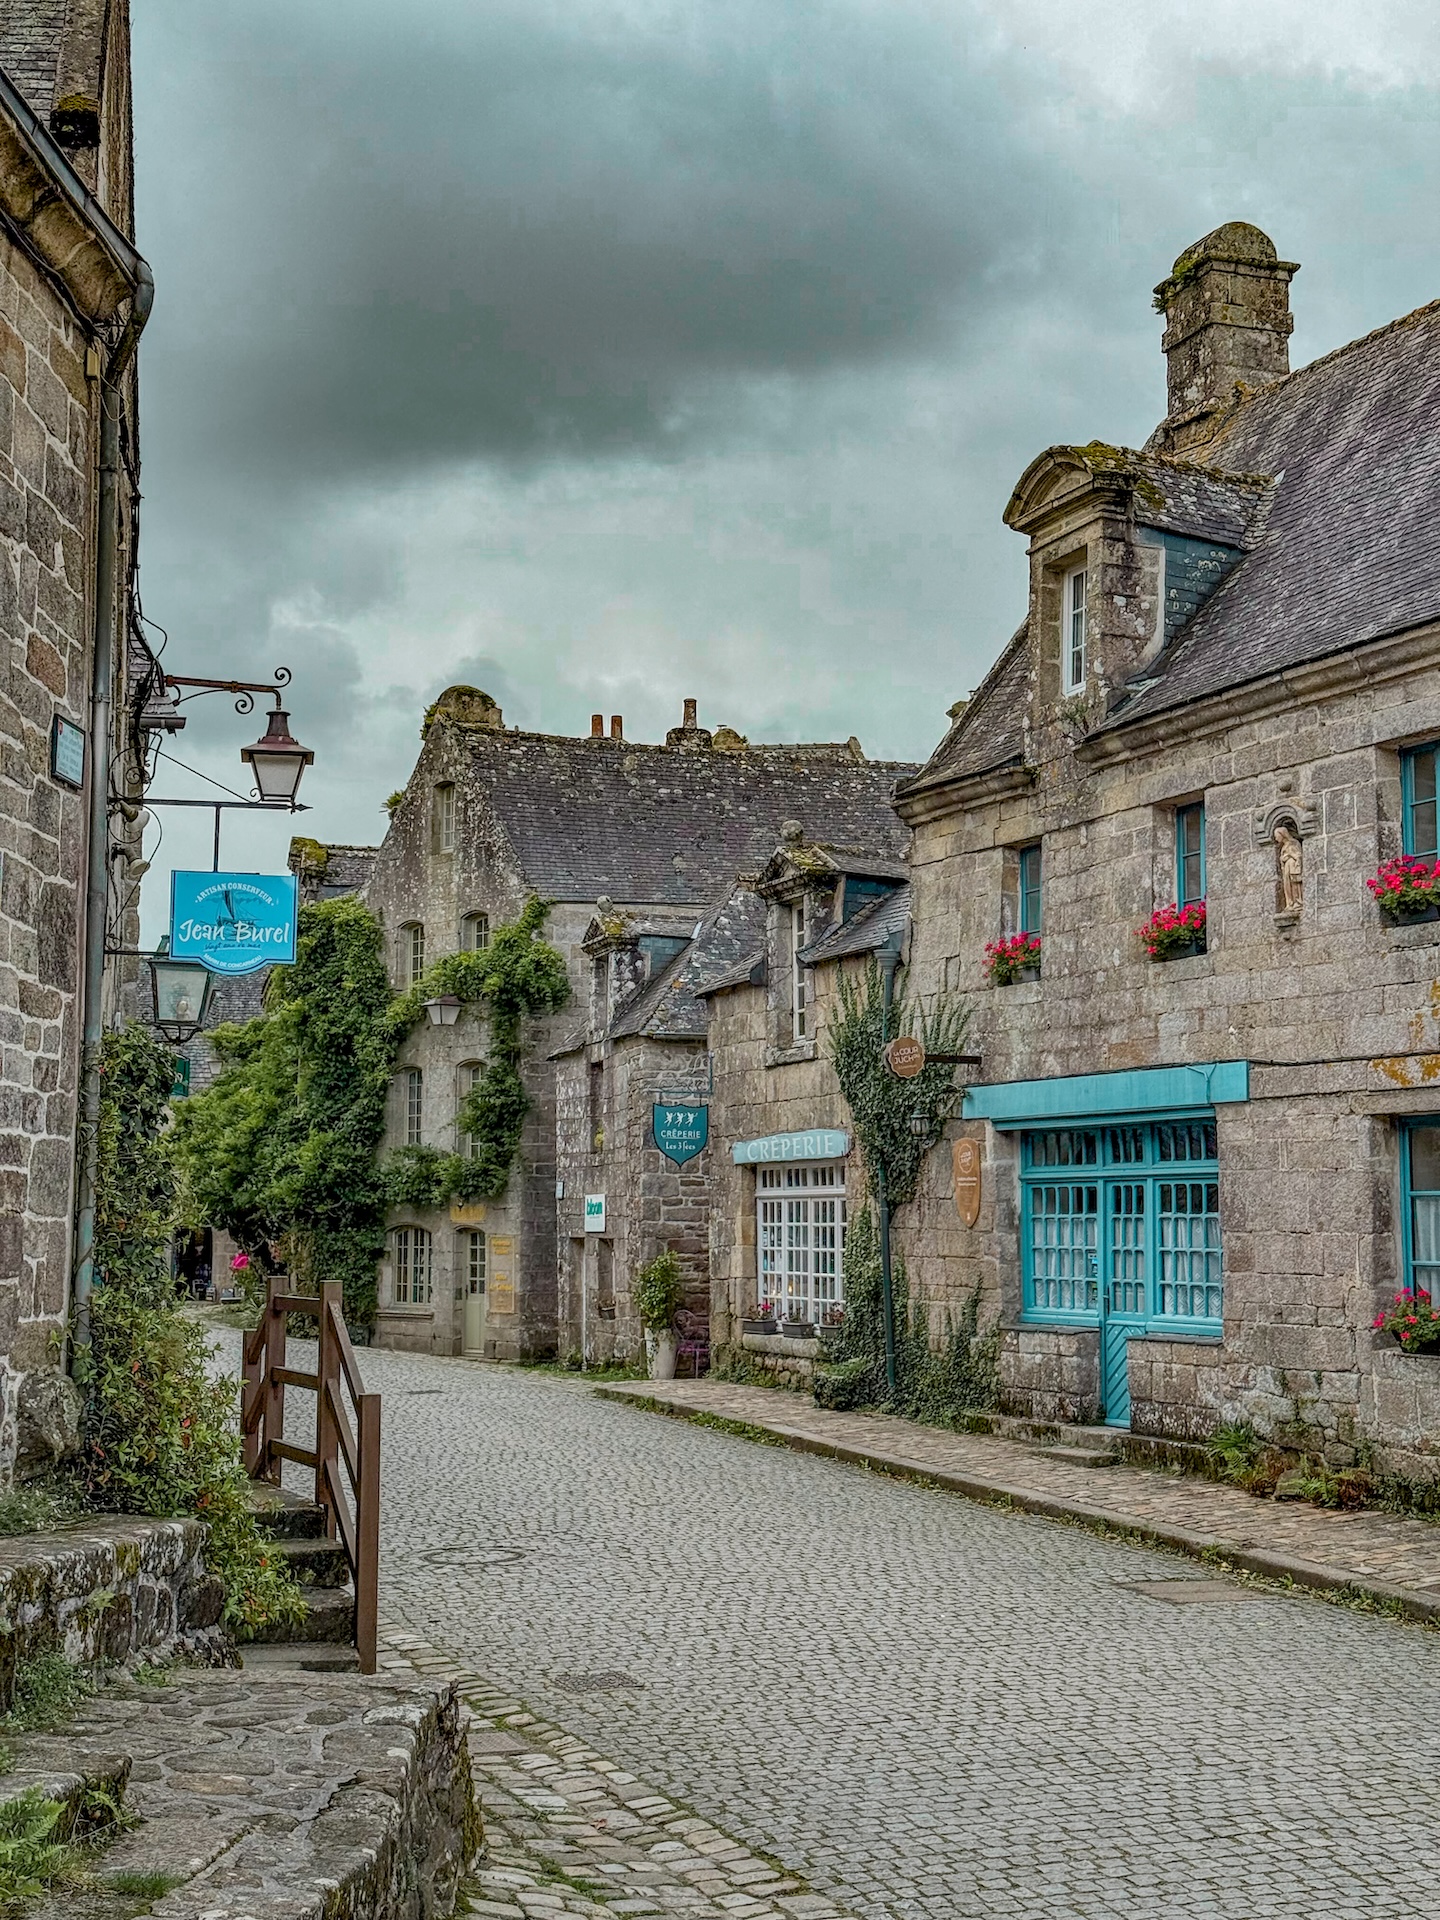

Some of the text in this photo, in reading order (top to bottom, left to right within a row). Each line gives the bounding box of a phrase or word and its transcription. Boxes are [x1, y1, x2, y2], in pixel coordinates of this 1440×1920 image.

[197, 882, 273, 904] ARTISAN CONSERVEUR
[178, 919, 289, 943] Jean Burel
[899, 1046, 919, 1056] COUR
[660, 1128, 701, 1138] CRÊPERIE
[665, 1141, 677, 1150] Les
[677, 1141, 682, 1150] 3
[746, 1134, 834, 1160] CRÊPERIE
